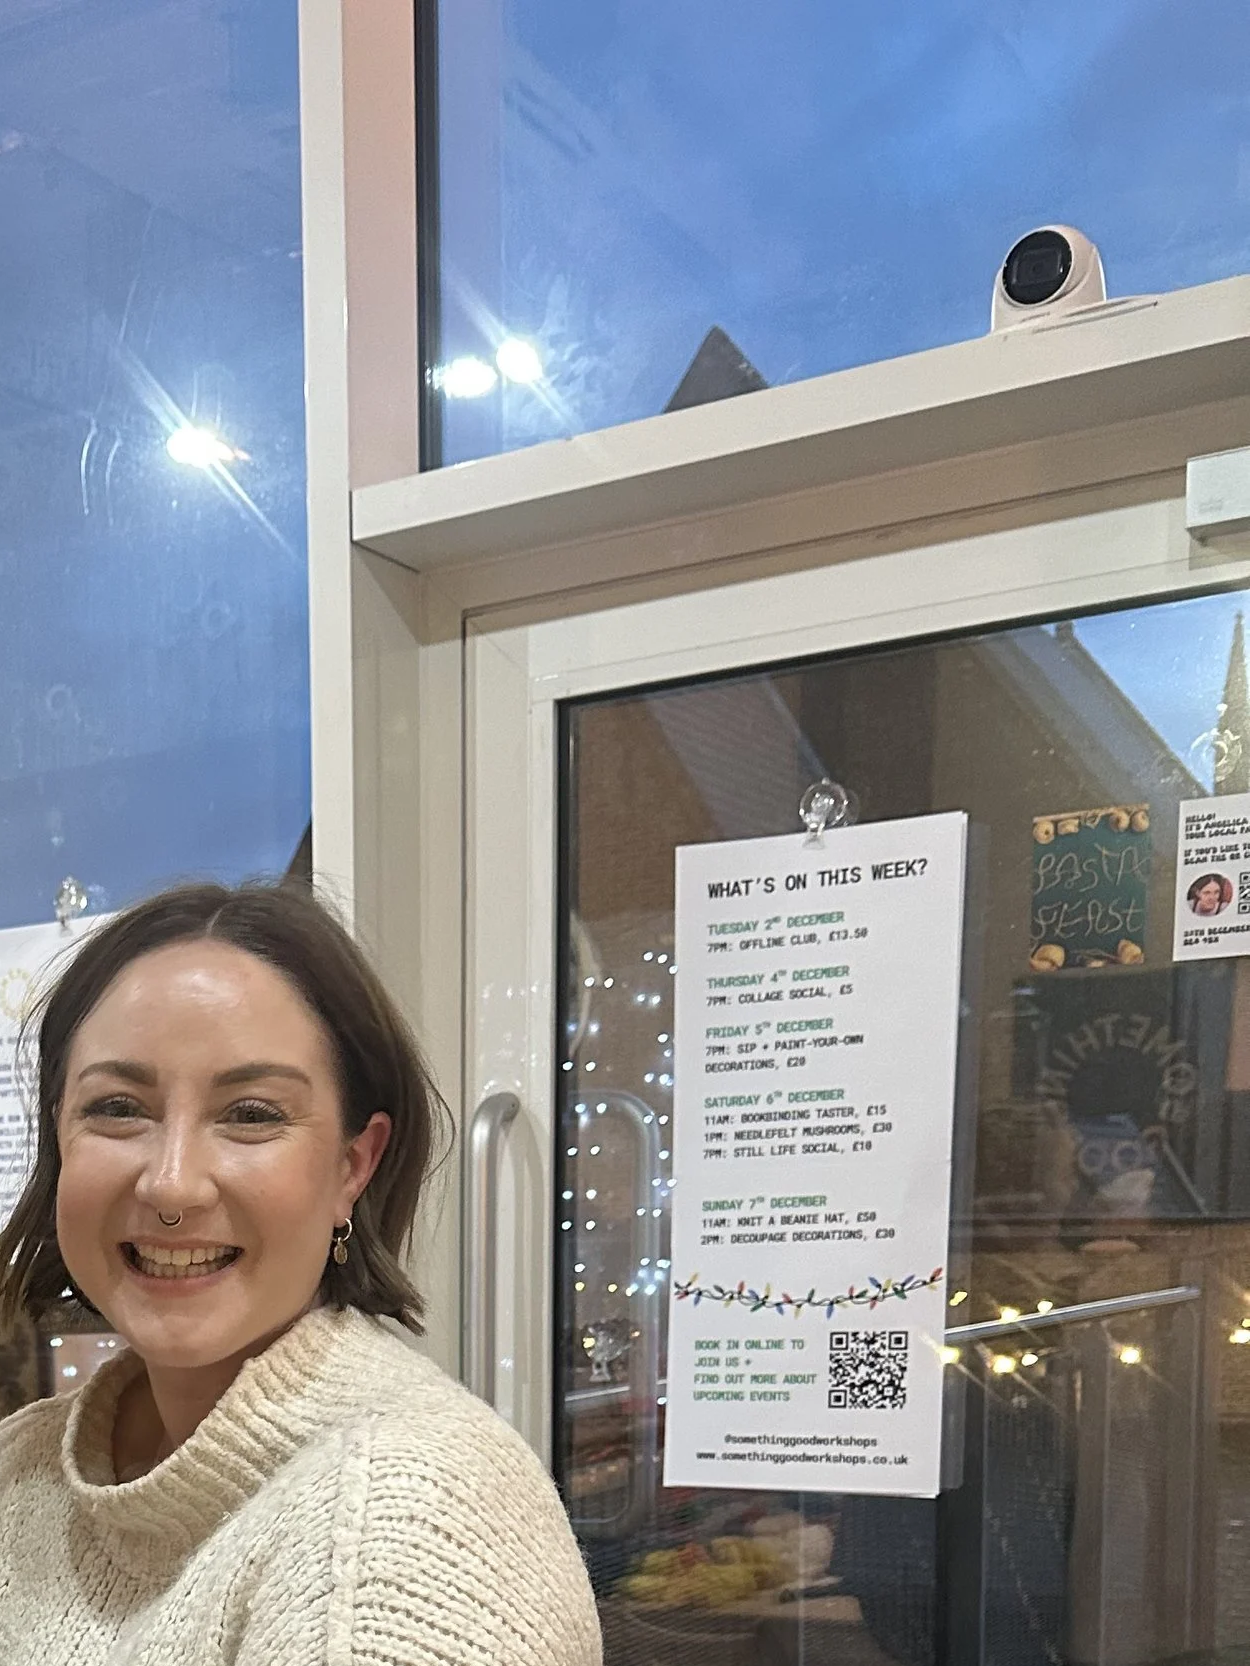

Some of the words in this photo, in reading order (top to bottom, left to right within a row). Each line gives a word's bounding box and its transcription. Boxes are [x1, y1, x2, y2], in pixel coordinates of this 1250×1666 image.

[1209, 829, 1237, 838] LOCAL
[708, 878, 775, 899] WHAT'S
[785, 874, 807, 891] ON
[818, 867, 862, 886] THIS
[871, 858, 928, 880] WEEK?
[708, 921, 758, 936] TUESDAY
[787, 911, 844, 928] DECEMBER
[707, 943, 733, 953] 7PM:
[740, 936, 784, 951] OFFLINE
[791, 932, 821, 946] CLUB,
[829, 927, 868, 942] £13.50
[707, 974, 764, 989] THURSDAY
[793, 965, 850, 981] DECEMBER
[706, 996, 731, 1006] 7PM:
[739, 990, 783, 1004] COLLAGE
[789, 987, 831, 999] SOCIAL,
[840, 984, 853, 995] £5
[706, 1025, 749, 1039] FRIDAY
[777, 1018, 833, 1033] DECEMBER
[706, 1045, 730, 1056] 7PM:
[738, 1043, 756, 1054] SIP
[775, 1035, 864, 1051] PAINT-YOUR-OWN
[705, 1060, 779, 1073] DECORATIONS,
[787, 1056, 806, 1068] £20
[705, 1095, 761, 1109] SATURDAY
[788, 1089, 844, 1103] DECEMBER
[705, 1116, 734, 1125] 11AM:
[741, 1110, 810, 1123] BOOKBINDING
[816, 1107, 858, 1119] TASTER,
[867, 1105, 886, 1116] £15
[705, 1132, 727, 1142] 1PM:
[734, 1128, 796, 1140] NEEDLEFELT
[802, 1124, 864, 1137] MUSHROOMS,
[873, 1122, 892, 1133] £30
[704, 1150, 727, 1159] 7PM:
[734, 1147, 764, 1158] STILL
[771, 1145, 795, 1156] LIFE
[802, 1143, 845, 1155] SOCIAL,
[853, 1140, 872, 1152] £10
[702, 1199, 743, 1212] SUNDAY
[770, 1195, 827, 1209] DECEMBER
[703, 1218, 731, 1228] 11AM:
[738, 1216, 763, 1226] KNIT
[768, 1216, 775, 1225] A
[781, 1213, 819, 1224] BEANIE
[825, 1213, 849, 1224] HAT,
[857, 1211, 876, 1222] £50
[701, 1235, 724, 1245] 2PM:
[731, 1232, 786, 1244] DECOUPAGE
[793, 1229, 867, 1242] DECORATIONS,
[876, 1228, 895, 1239] £30
[695, 1340, 720, 1350] BOOK
[726, 1340, 739, 1350] IN
[745, 1340, 784, 1350] ONLINE
[791, 1340, 804, 1350] TO
[694, 1357, 720, 1367] JOIN
[726, 1357, 739, 1367] US
[694, 1374, 720, 1384] FIND
[725, 1374, 745, 1383] OUT
[751, 1374, 777, 1384] MORE
[783, 1374, 817, 1384] ABOUT
[693, 1391, 745, 1401] UPCOMING
[750, 1391, 790, 1401] EVENTS
[724, 1434, 877, 1448] @somethinggoodworkshops
[697, 1452, 908, 1465] www.somethinggoodworkshops.co.uk
